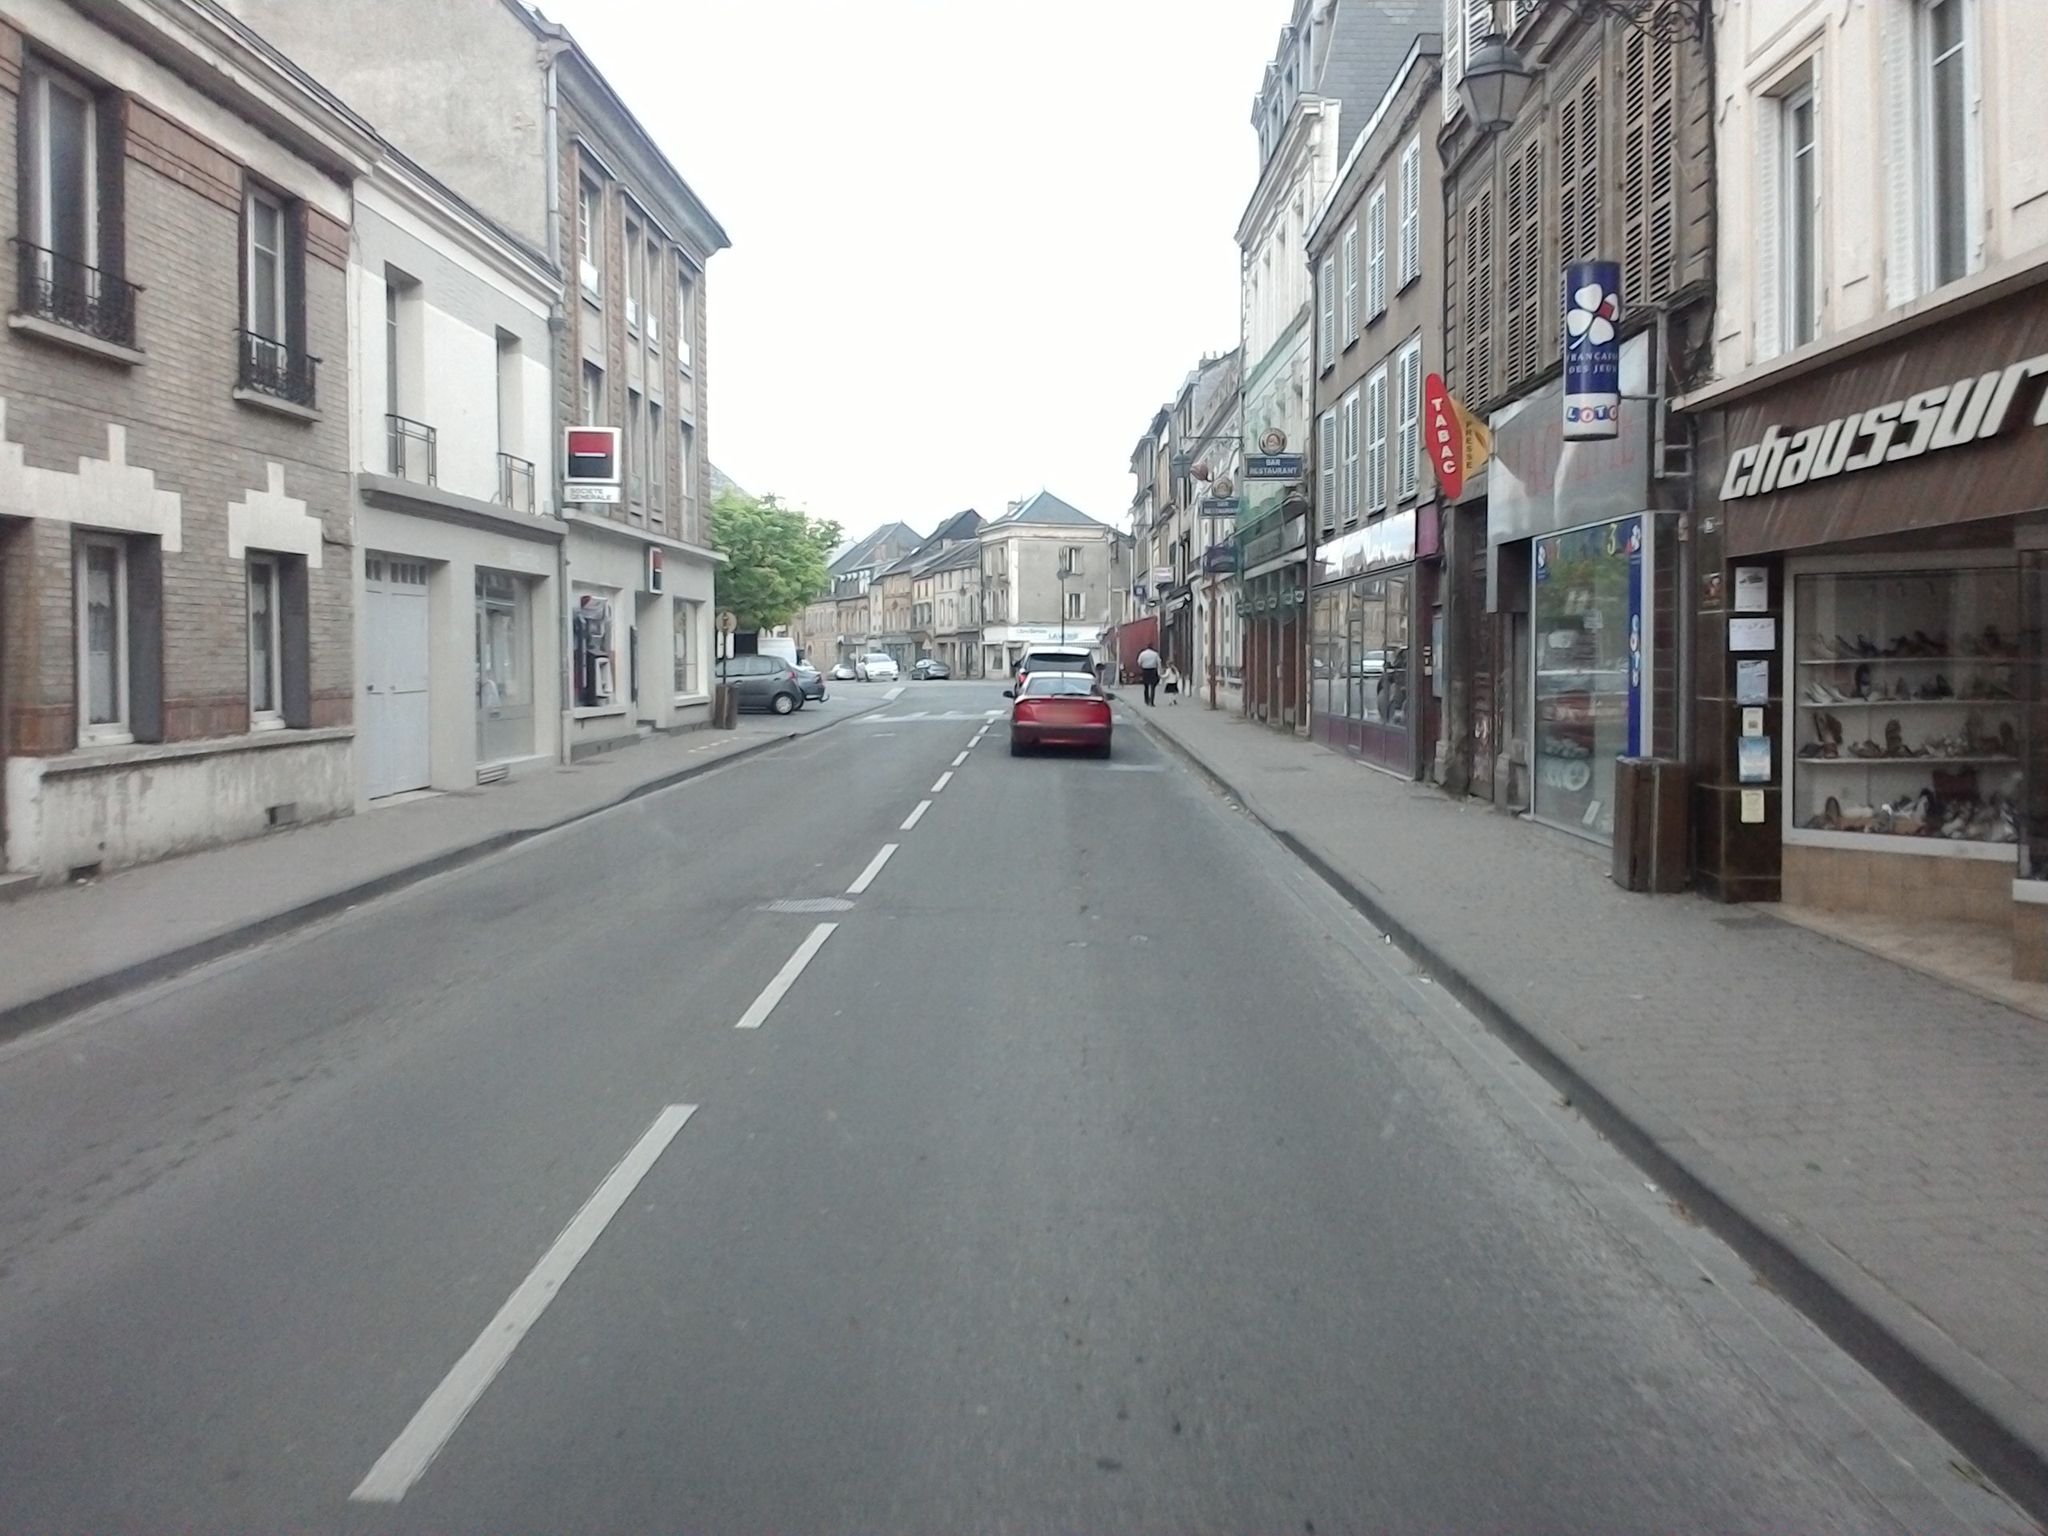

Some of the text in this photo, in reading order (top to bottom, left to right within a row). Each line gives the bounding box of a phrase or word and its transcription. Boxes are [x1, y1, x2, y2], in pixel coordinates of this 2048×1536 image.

[1568, 365, 1589, 375] DES
[1566, 405, 1618, 423] LOTO
[1431, 398, 1456, 474] TABAC
[1719, 353, 2048, 501] chaussur
[1465, 421, 1473, 469] PRESSE
[1249, 467, 1298, 475] RESTAURANT
[1265, 458, 1281, 466] BAR
